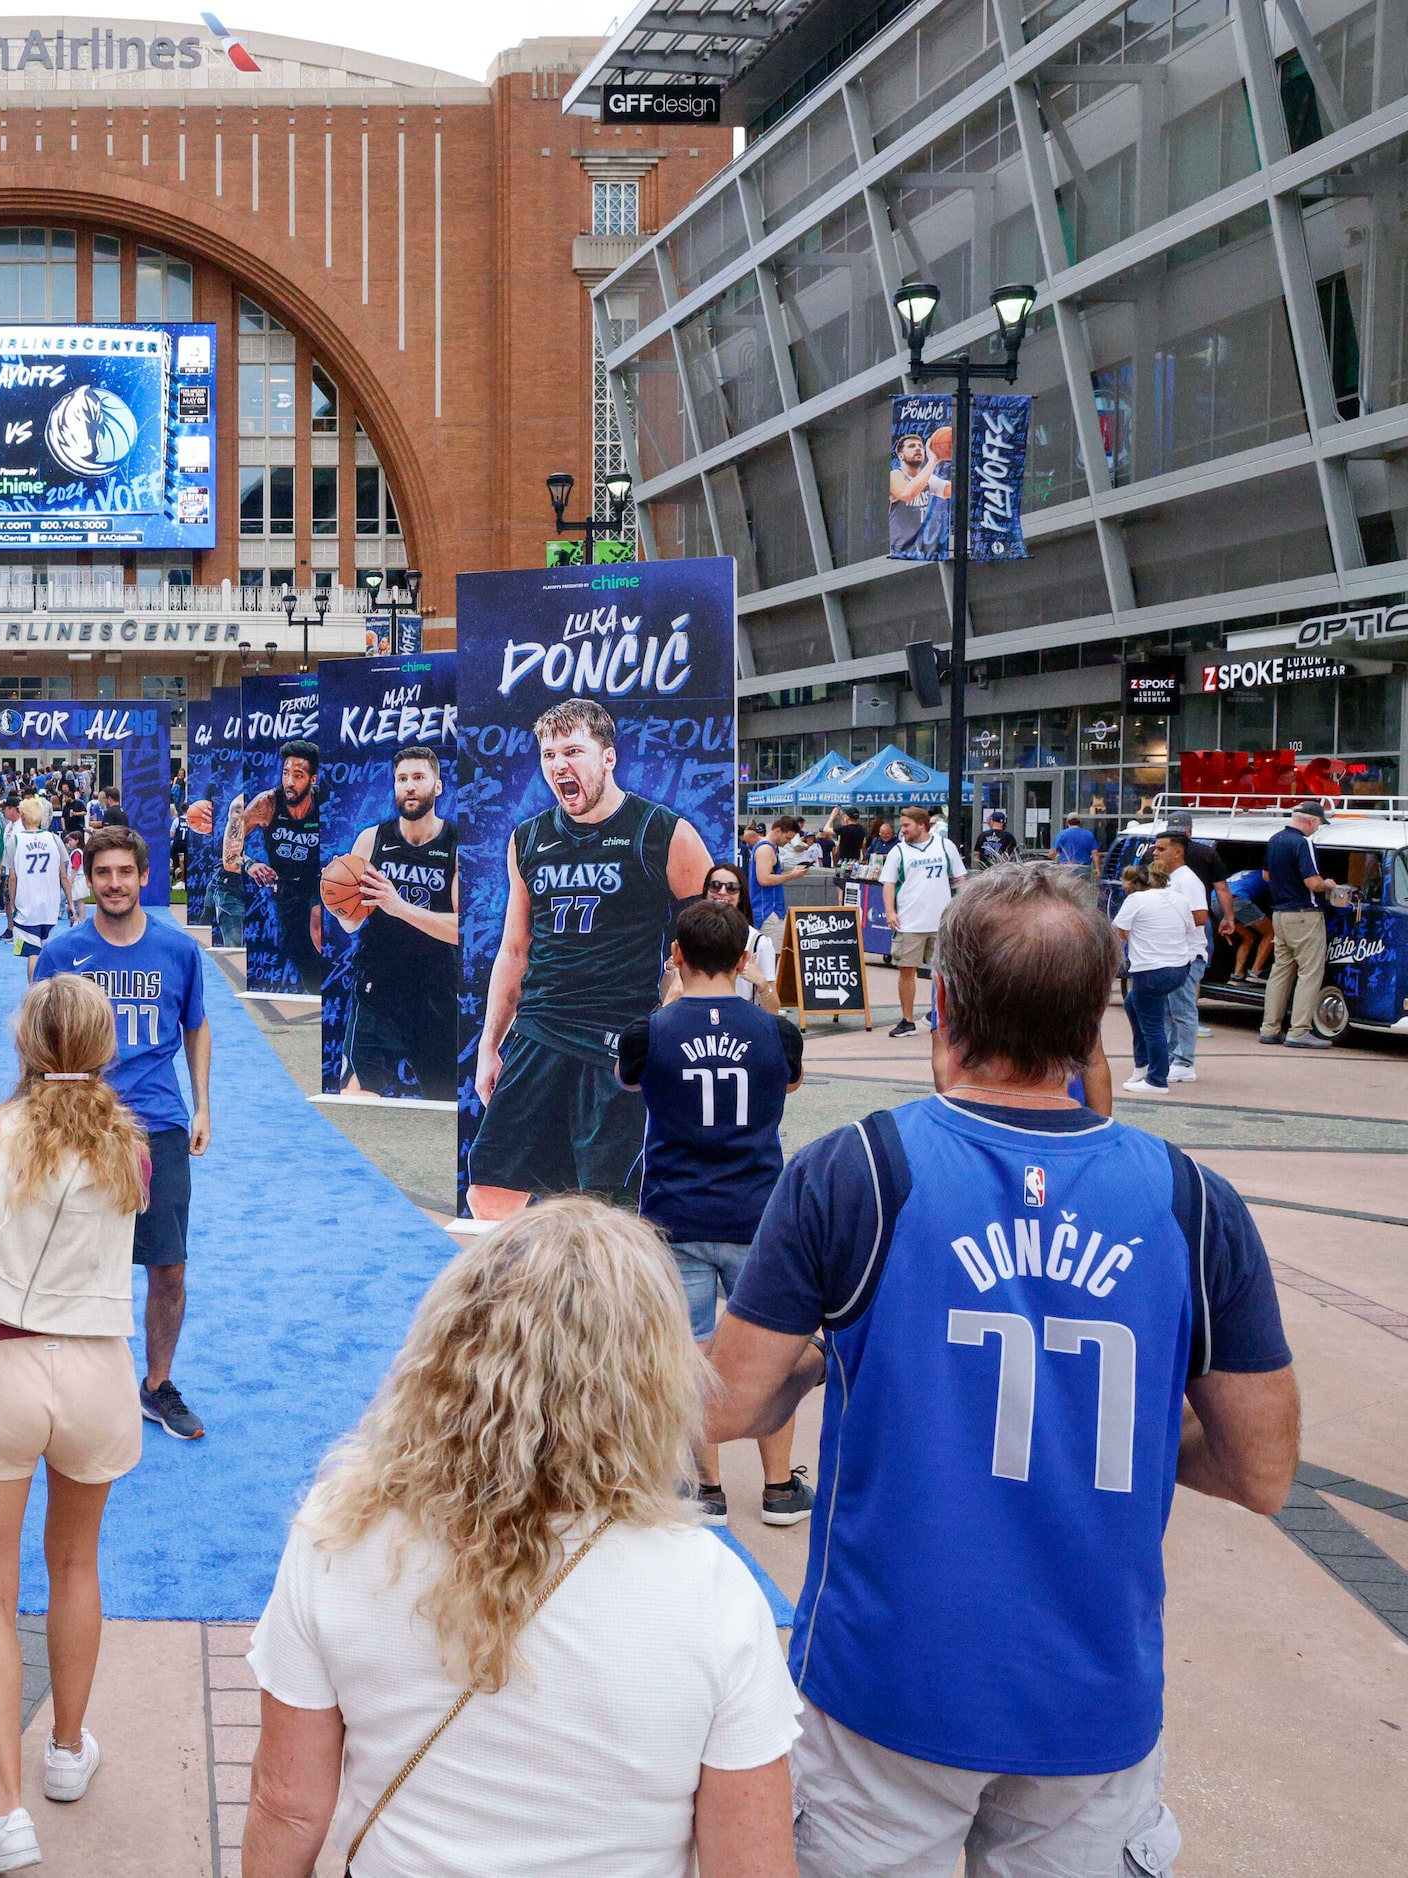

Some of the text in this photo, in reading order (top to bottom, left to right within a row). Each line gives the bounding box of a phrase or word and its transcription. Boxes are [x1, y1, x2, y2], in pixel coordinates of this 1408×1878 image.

[17, 28, 202, 71] Airlines
[182, 397, 196, 405] MAY
[900, 401, 944, 420] DONČIĆ
[4, 420, 33, 446] VS
[974, 411, 1015, 534] PLAYOFFS
[46, 481, 88, 504] 2024
[40, 520, 108, 530] 800.745.3000
[591, 574, 640, 590] chime
[562, 605, 620, 642] LUKA
[498, 613, 693, 697] DONČIĆ
[401, 661, 432, 673] chime
[1286, 664, 1346, 681] MENSWEAR
[382, 684, 422, 708] MAXI
[21, 710, 70, 743] FOR
[84, 708, 135, 741] ALL
[247, 710, 319, 740] JONES
[339, 703, 458, 749] KLEBER
[1288, 741, 1303, 752] 103
[856, 793, 904, 803] DALLAS
[271, 827, 319, 846] MAVS
[602, 837, 631, 848] chime
[275, 843, 308, 860] 55
[428, 849, 449, 858] chime
[25, 853, 50, 874] 77
[925, 865, 943, 879] 77
[378, 861, 447, 891] MAVS
[533, 861, 622, 895] MAVS
[550, 896, 601, 934] 77
[796, 915, 855, 937] Photo Bus
[1354, 938, 1386, 962] Bus
[804, 955, 850, 971] FREE
[803, 971, 858, 986] PHOTOS
[117, 1004, 159, 1046] 77
[679, 1031, 753, 1063] DONČIĆ
[682, 1067, 749, 1127] 77
[950, 1209, 1144, 1298] DONČIĆ
[947, 1308, 1137, 1493] 77
